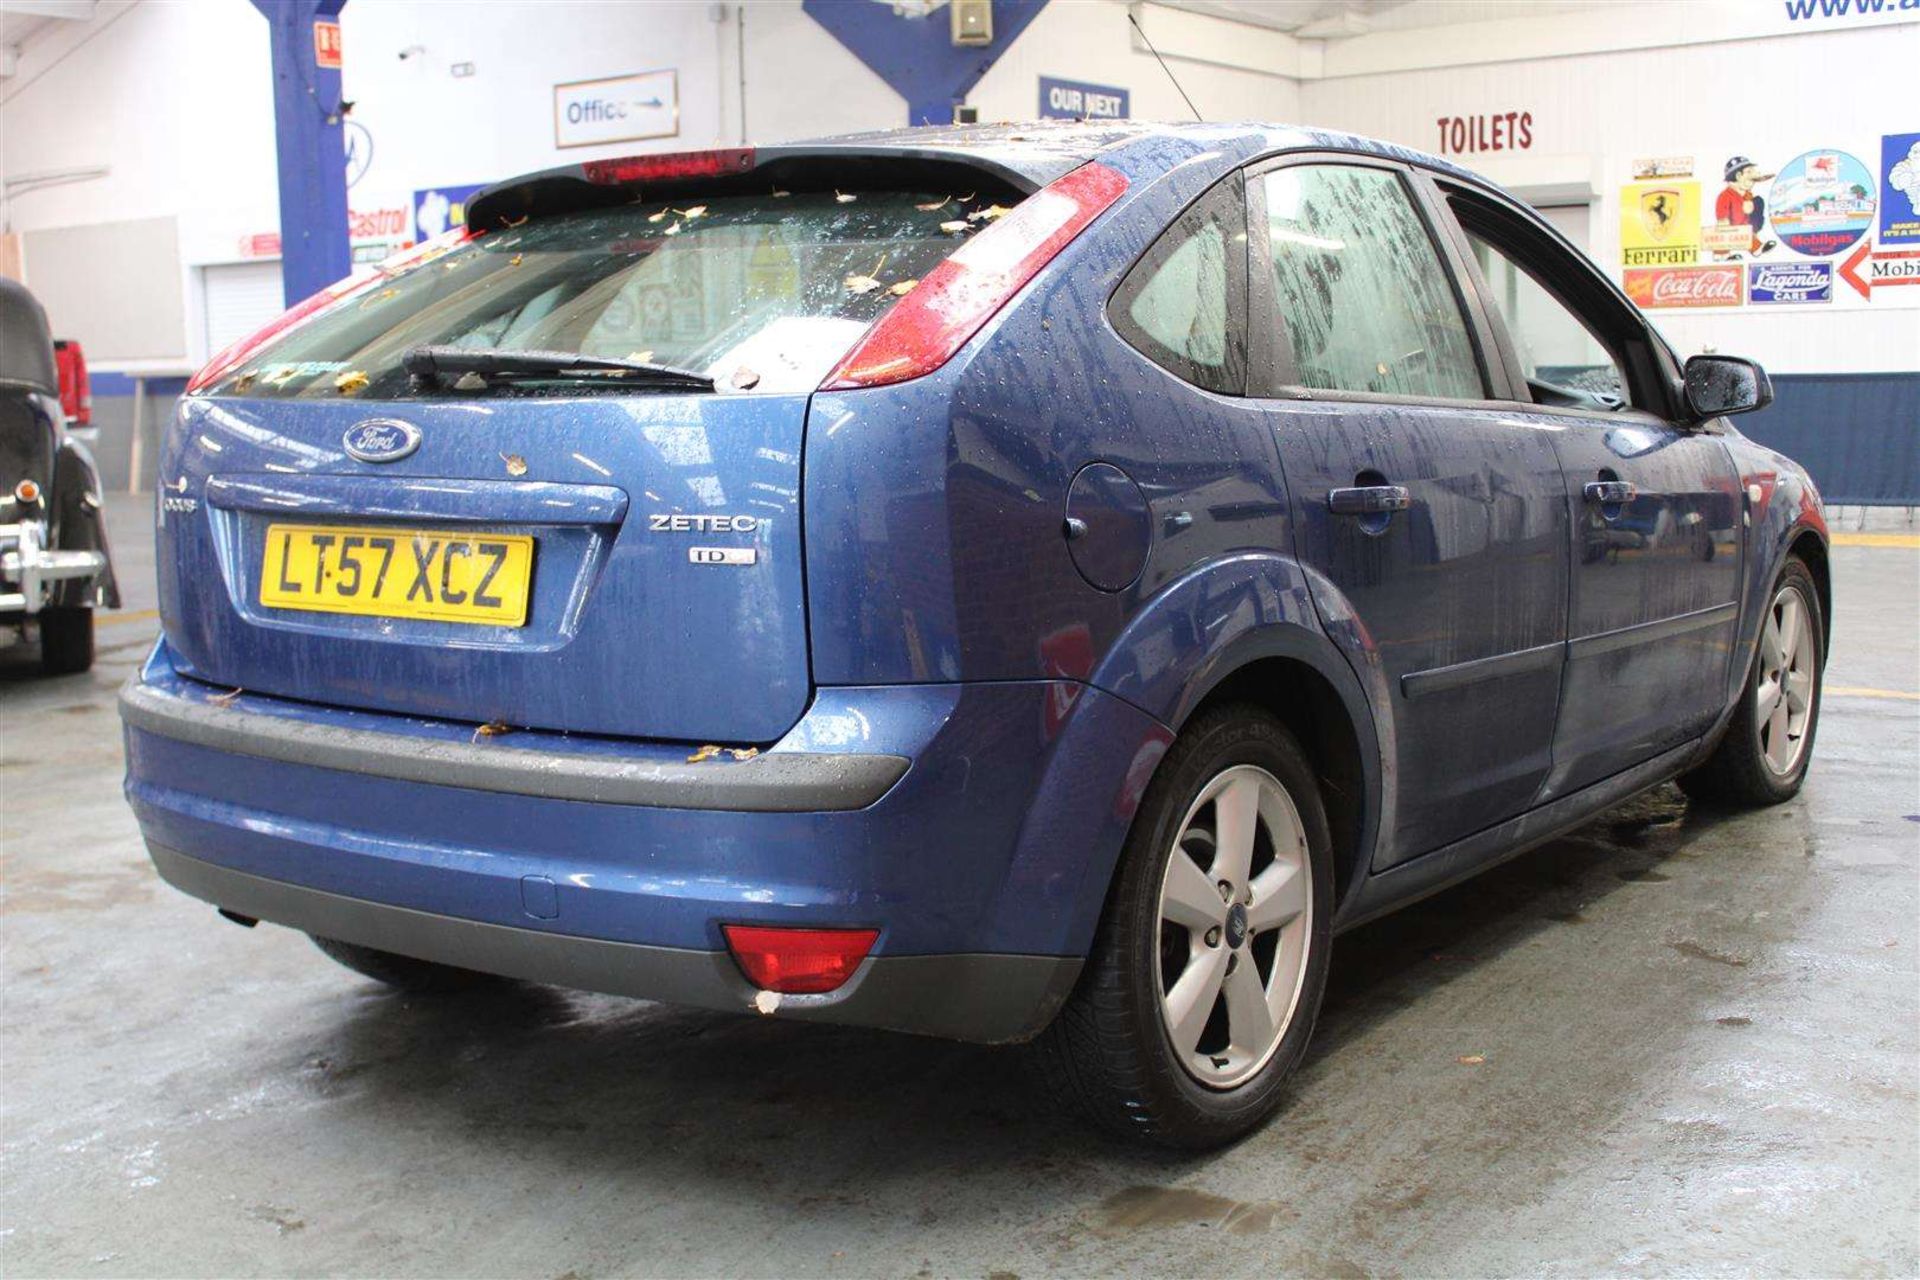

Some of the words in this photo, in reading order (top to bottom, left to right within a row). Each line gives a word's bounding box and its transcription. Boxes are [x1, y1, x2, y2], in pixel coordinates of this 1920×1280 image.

[1049, 86, 1082, 113] OUR
[1085, 92, 1121, 118] NEXT
[1437, 112, 1532, 154] TOILETS
[1624, 246, 1697, 265] Ferrari
[1752, 270, 1830, 293] Lagonda
[1773, 292, 1808, 301] CARS
[357, 425, 397, 452] Ford
[648, 513, 757, 532] ZETEC
[279, 533, 396, 599] LT57
[406, 540, 509, 609] XCZ
